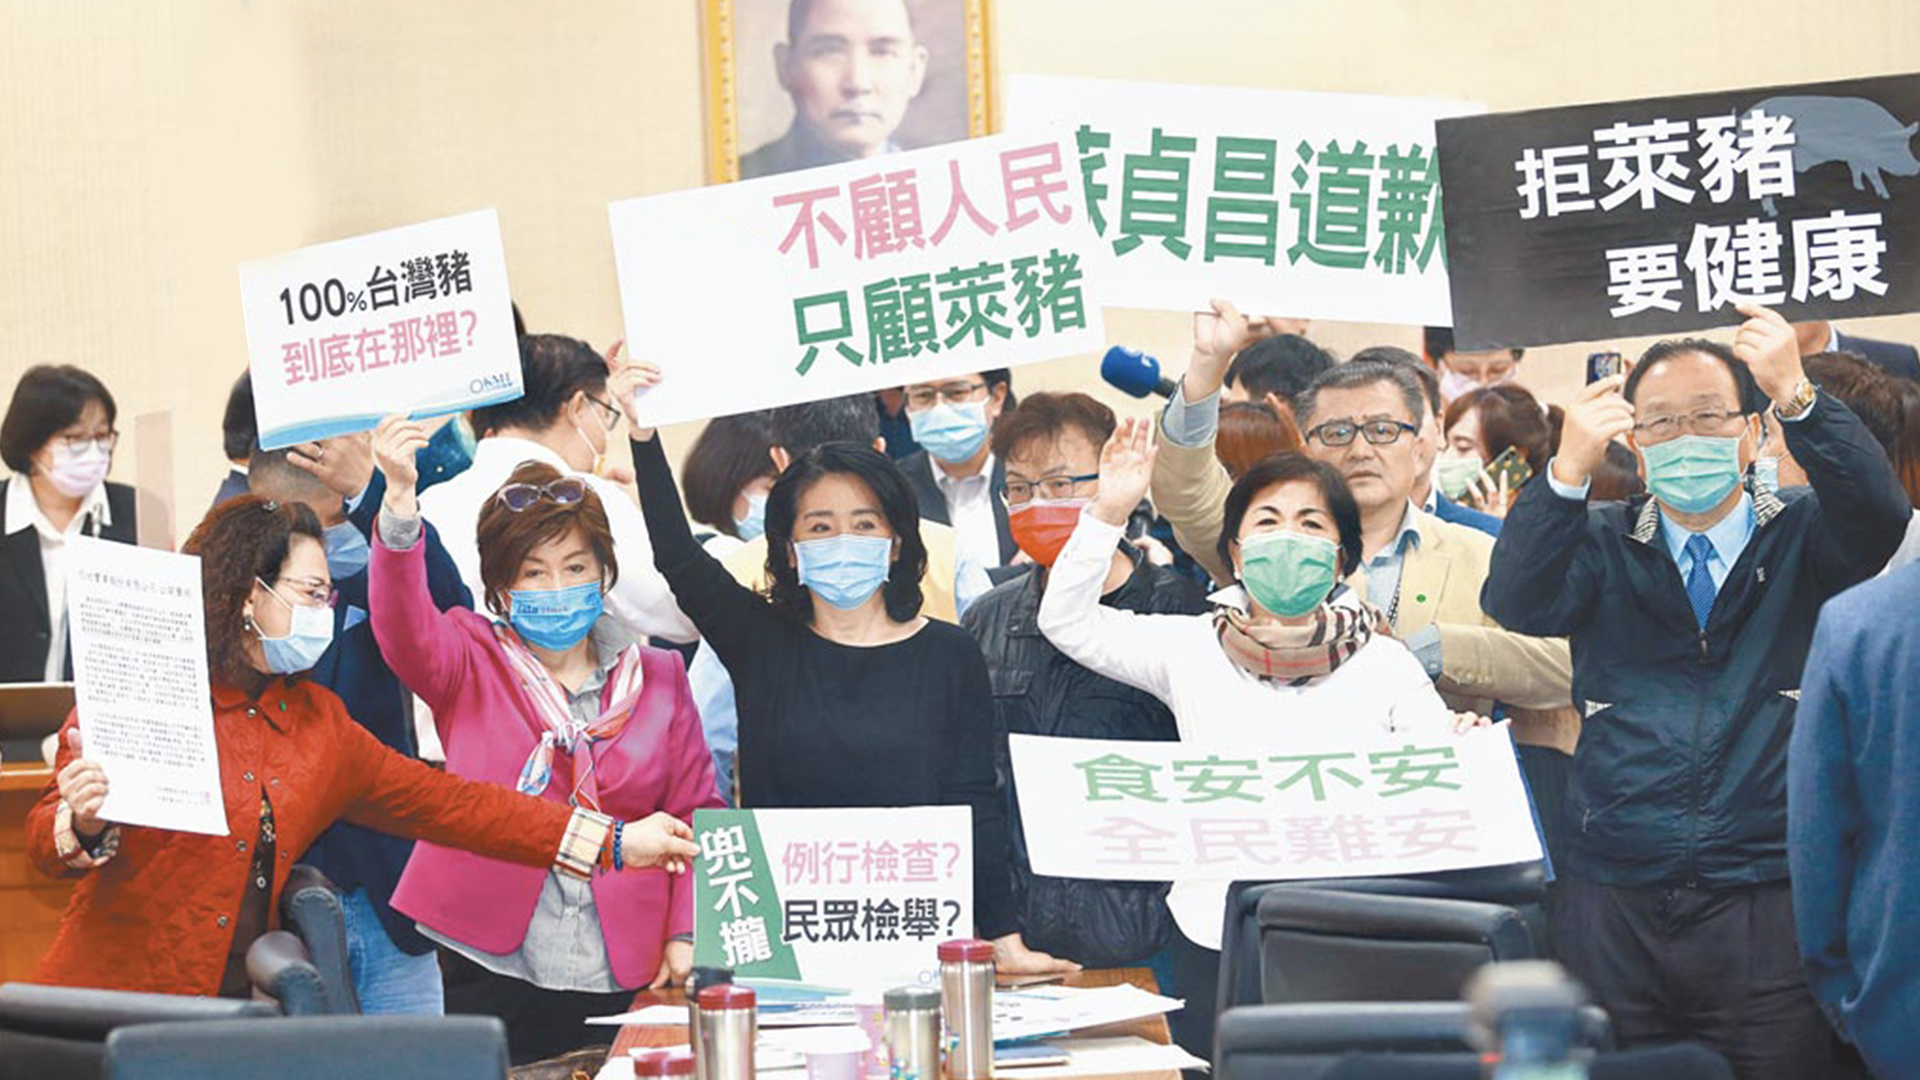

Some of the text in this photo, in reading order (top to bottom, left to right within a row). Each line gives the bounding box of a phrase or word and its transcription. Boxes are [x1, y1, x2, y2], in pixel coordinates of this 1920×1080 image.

[1515, 108, 1797, 220] 拒萊豬
[772, 142, 1073, 269] 不顧人民
[279, 249, 474, 325] 100%台灣豬
[1605, 208, 1889, 319] 要健康
[282, 309, 479, 386] 到底在那裡?
[794, 247, 1088, 376] 只顧萊豬
[1073, 744, 1462, 804] 食安不安
[782, 840, 961, 885] 例行檢查?
[1087, 807, 1478, 867] 全民難安
[700, 825, 772, 967] 兜不攏
[783, 898, 961, 943] 民眾檢舉?
